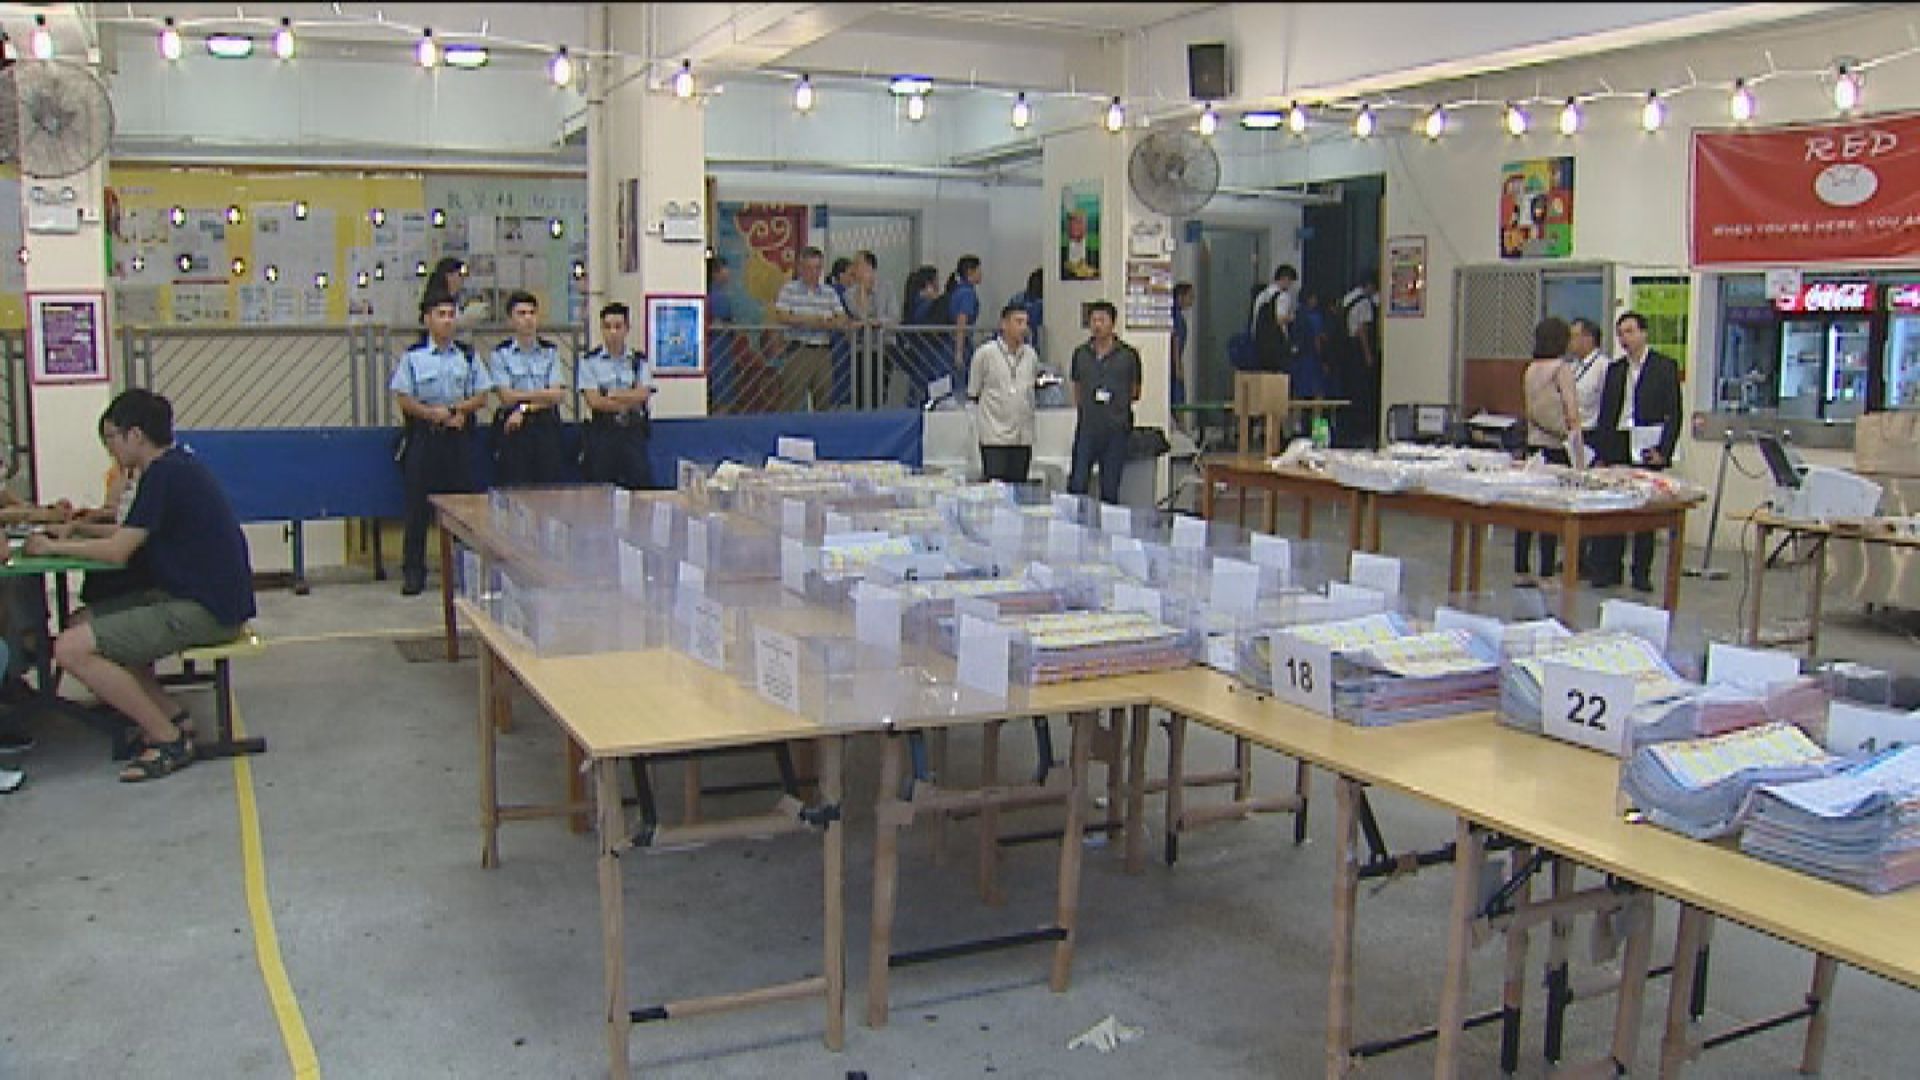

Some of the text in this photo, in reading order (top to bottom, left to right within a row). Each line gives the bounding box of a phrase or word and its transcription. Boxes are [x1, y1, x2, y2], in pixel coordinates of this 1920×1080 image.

[1804, 130, 1897, 161] RED
[1286, 657, 1313, 693] 18
[1567, 688, 1606, 731] 22
